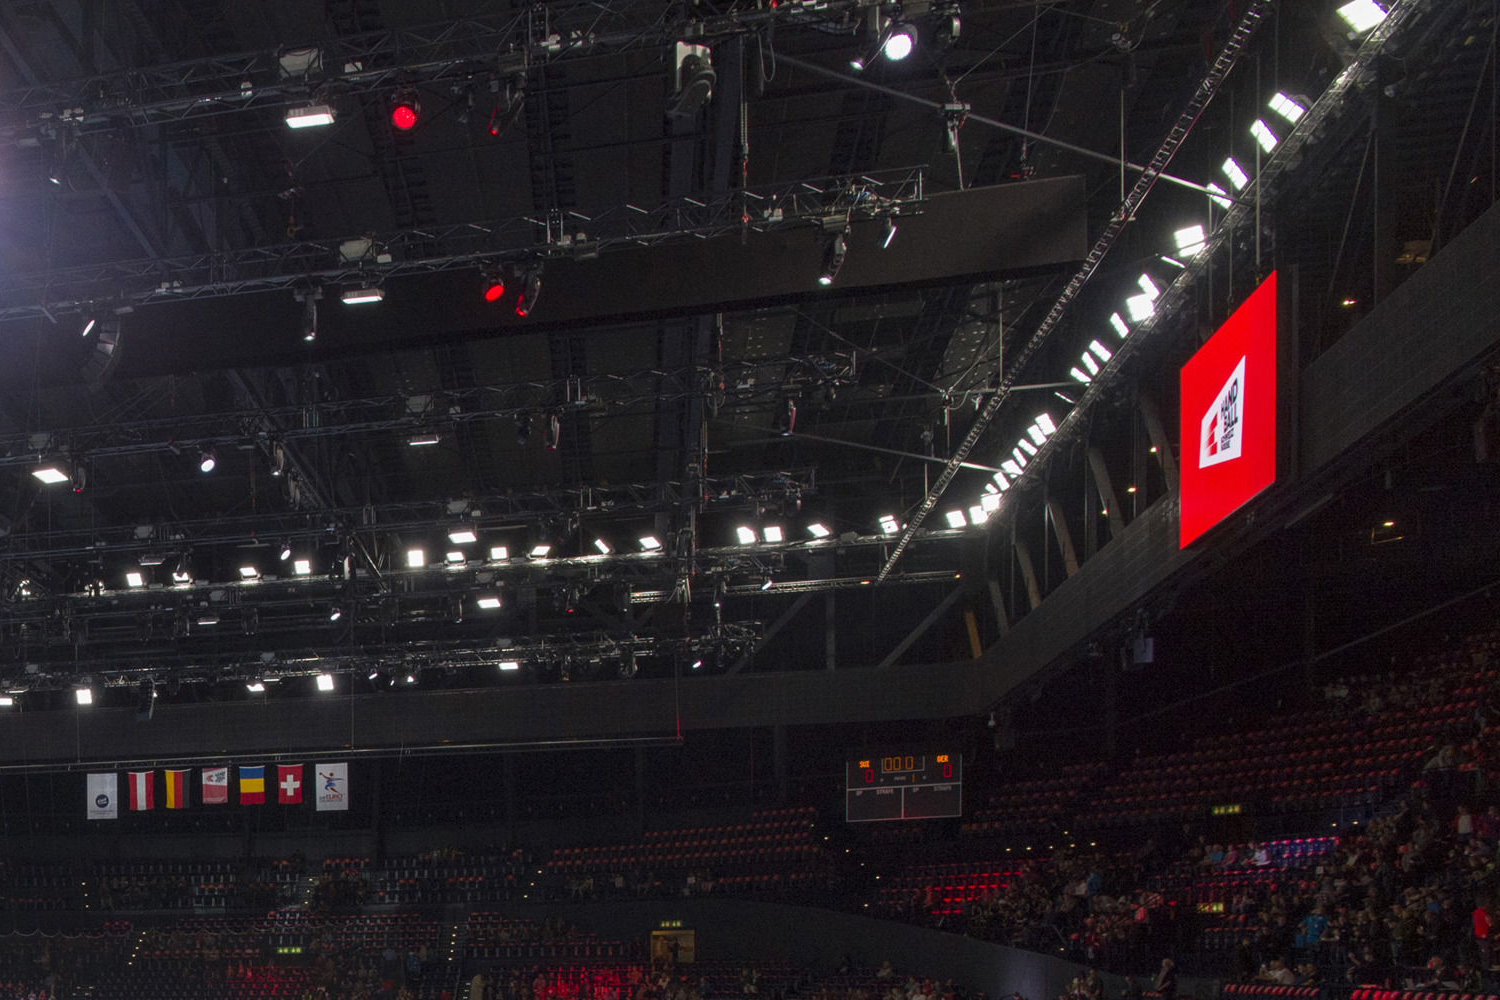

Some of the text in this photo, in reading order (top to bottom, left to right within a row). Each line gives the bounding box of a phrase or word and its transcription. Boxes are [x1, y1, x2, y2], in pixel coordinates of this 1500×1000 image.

[1221, 377, 1239, 418] HAND
[1224, 403, 1239, 432] BALL
[865, 769, 874, 783] 0
[943, 764, 952, 778] 0
